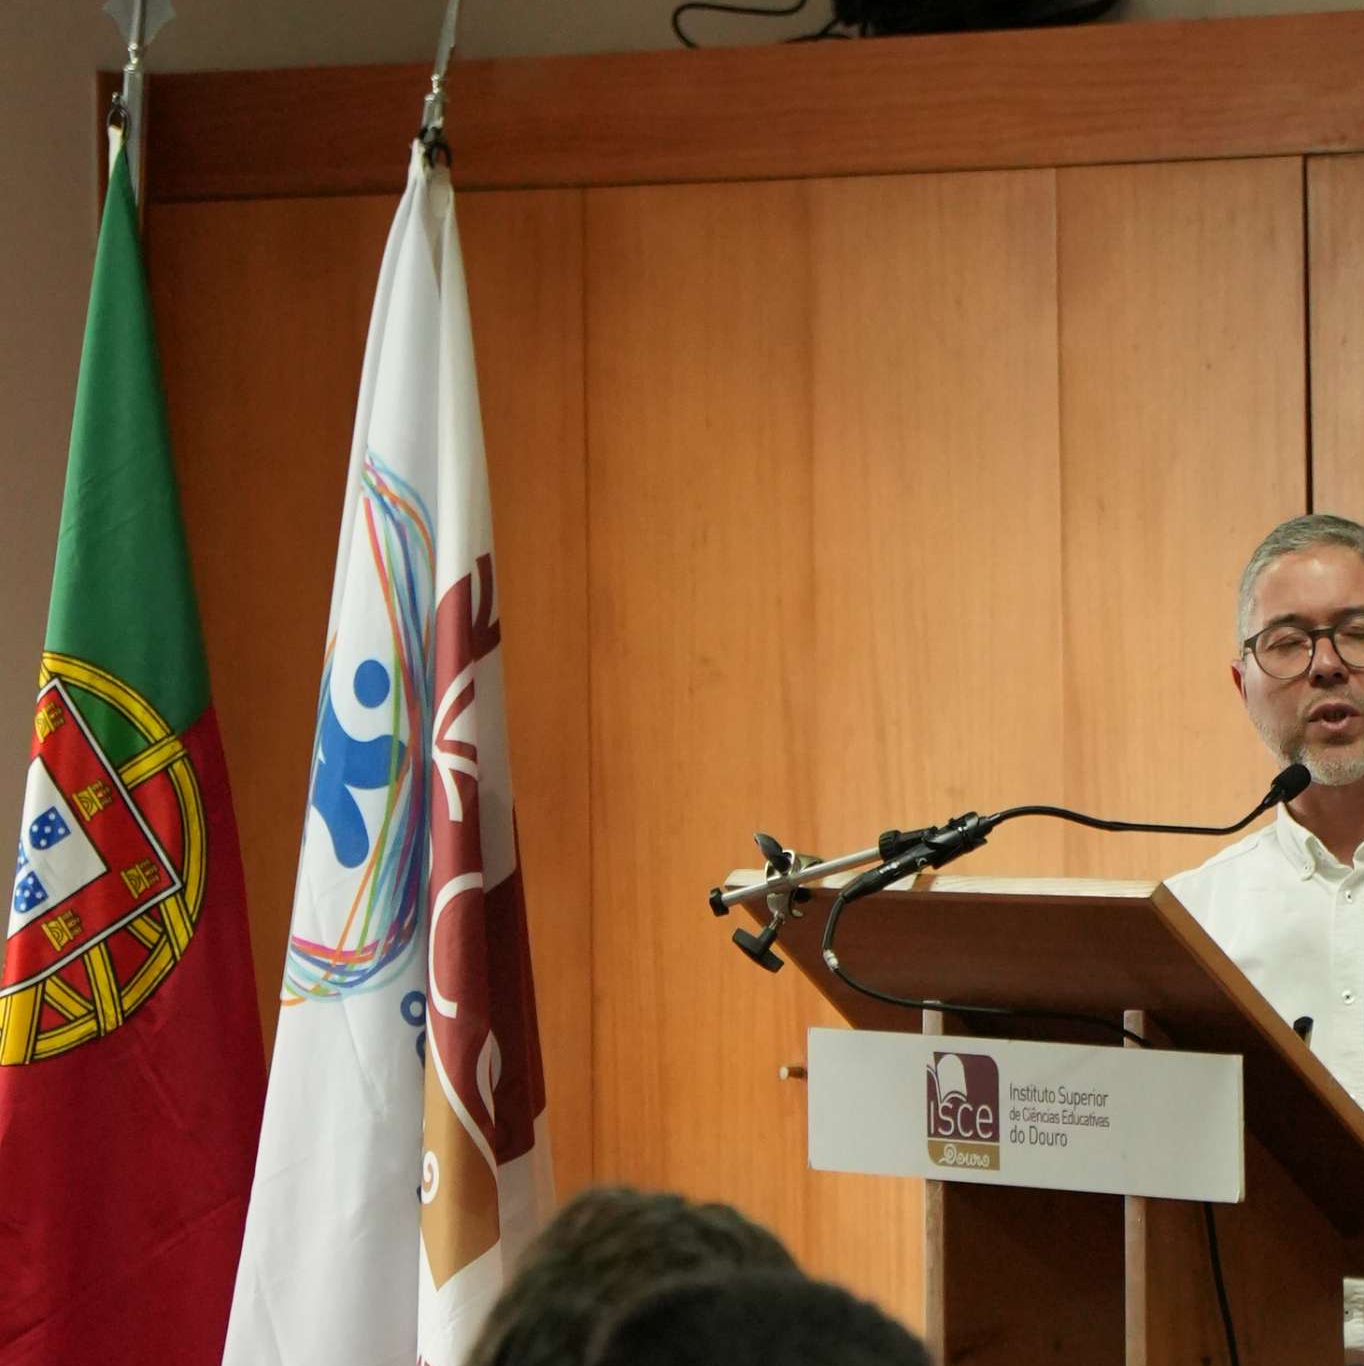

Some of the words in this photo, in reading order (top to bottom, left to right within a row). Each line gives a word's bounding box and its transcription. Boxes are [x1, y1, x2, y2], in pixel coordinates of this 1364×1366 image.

[1008, 1083, 1056, 1104] Instituto
[1057, 1085, 1109, 1111] Superior
[1008, 1106, 1021, 1122] de
[1022, 1106, 1060, 1125] Ciências
[1061, 1108, 1111, 1129] Educativas
[1008, 1124, 1026, 1145] do
[1028, 1125, 1068, 1148] Douro
